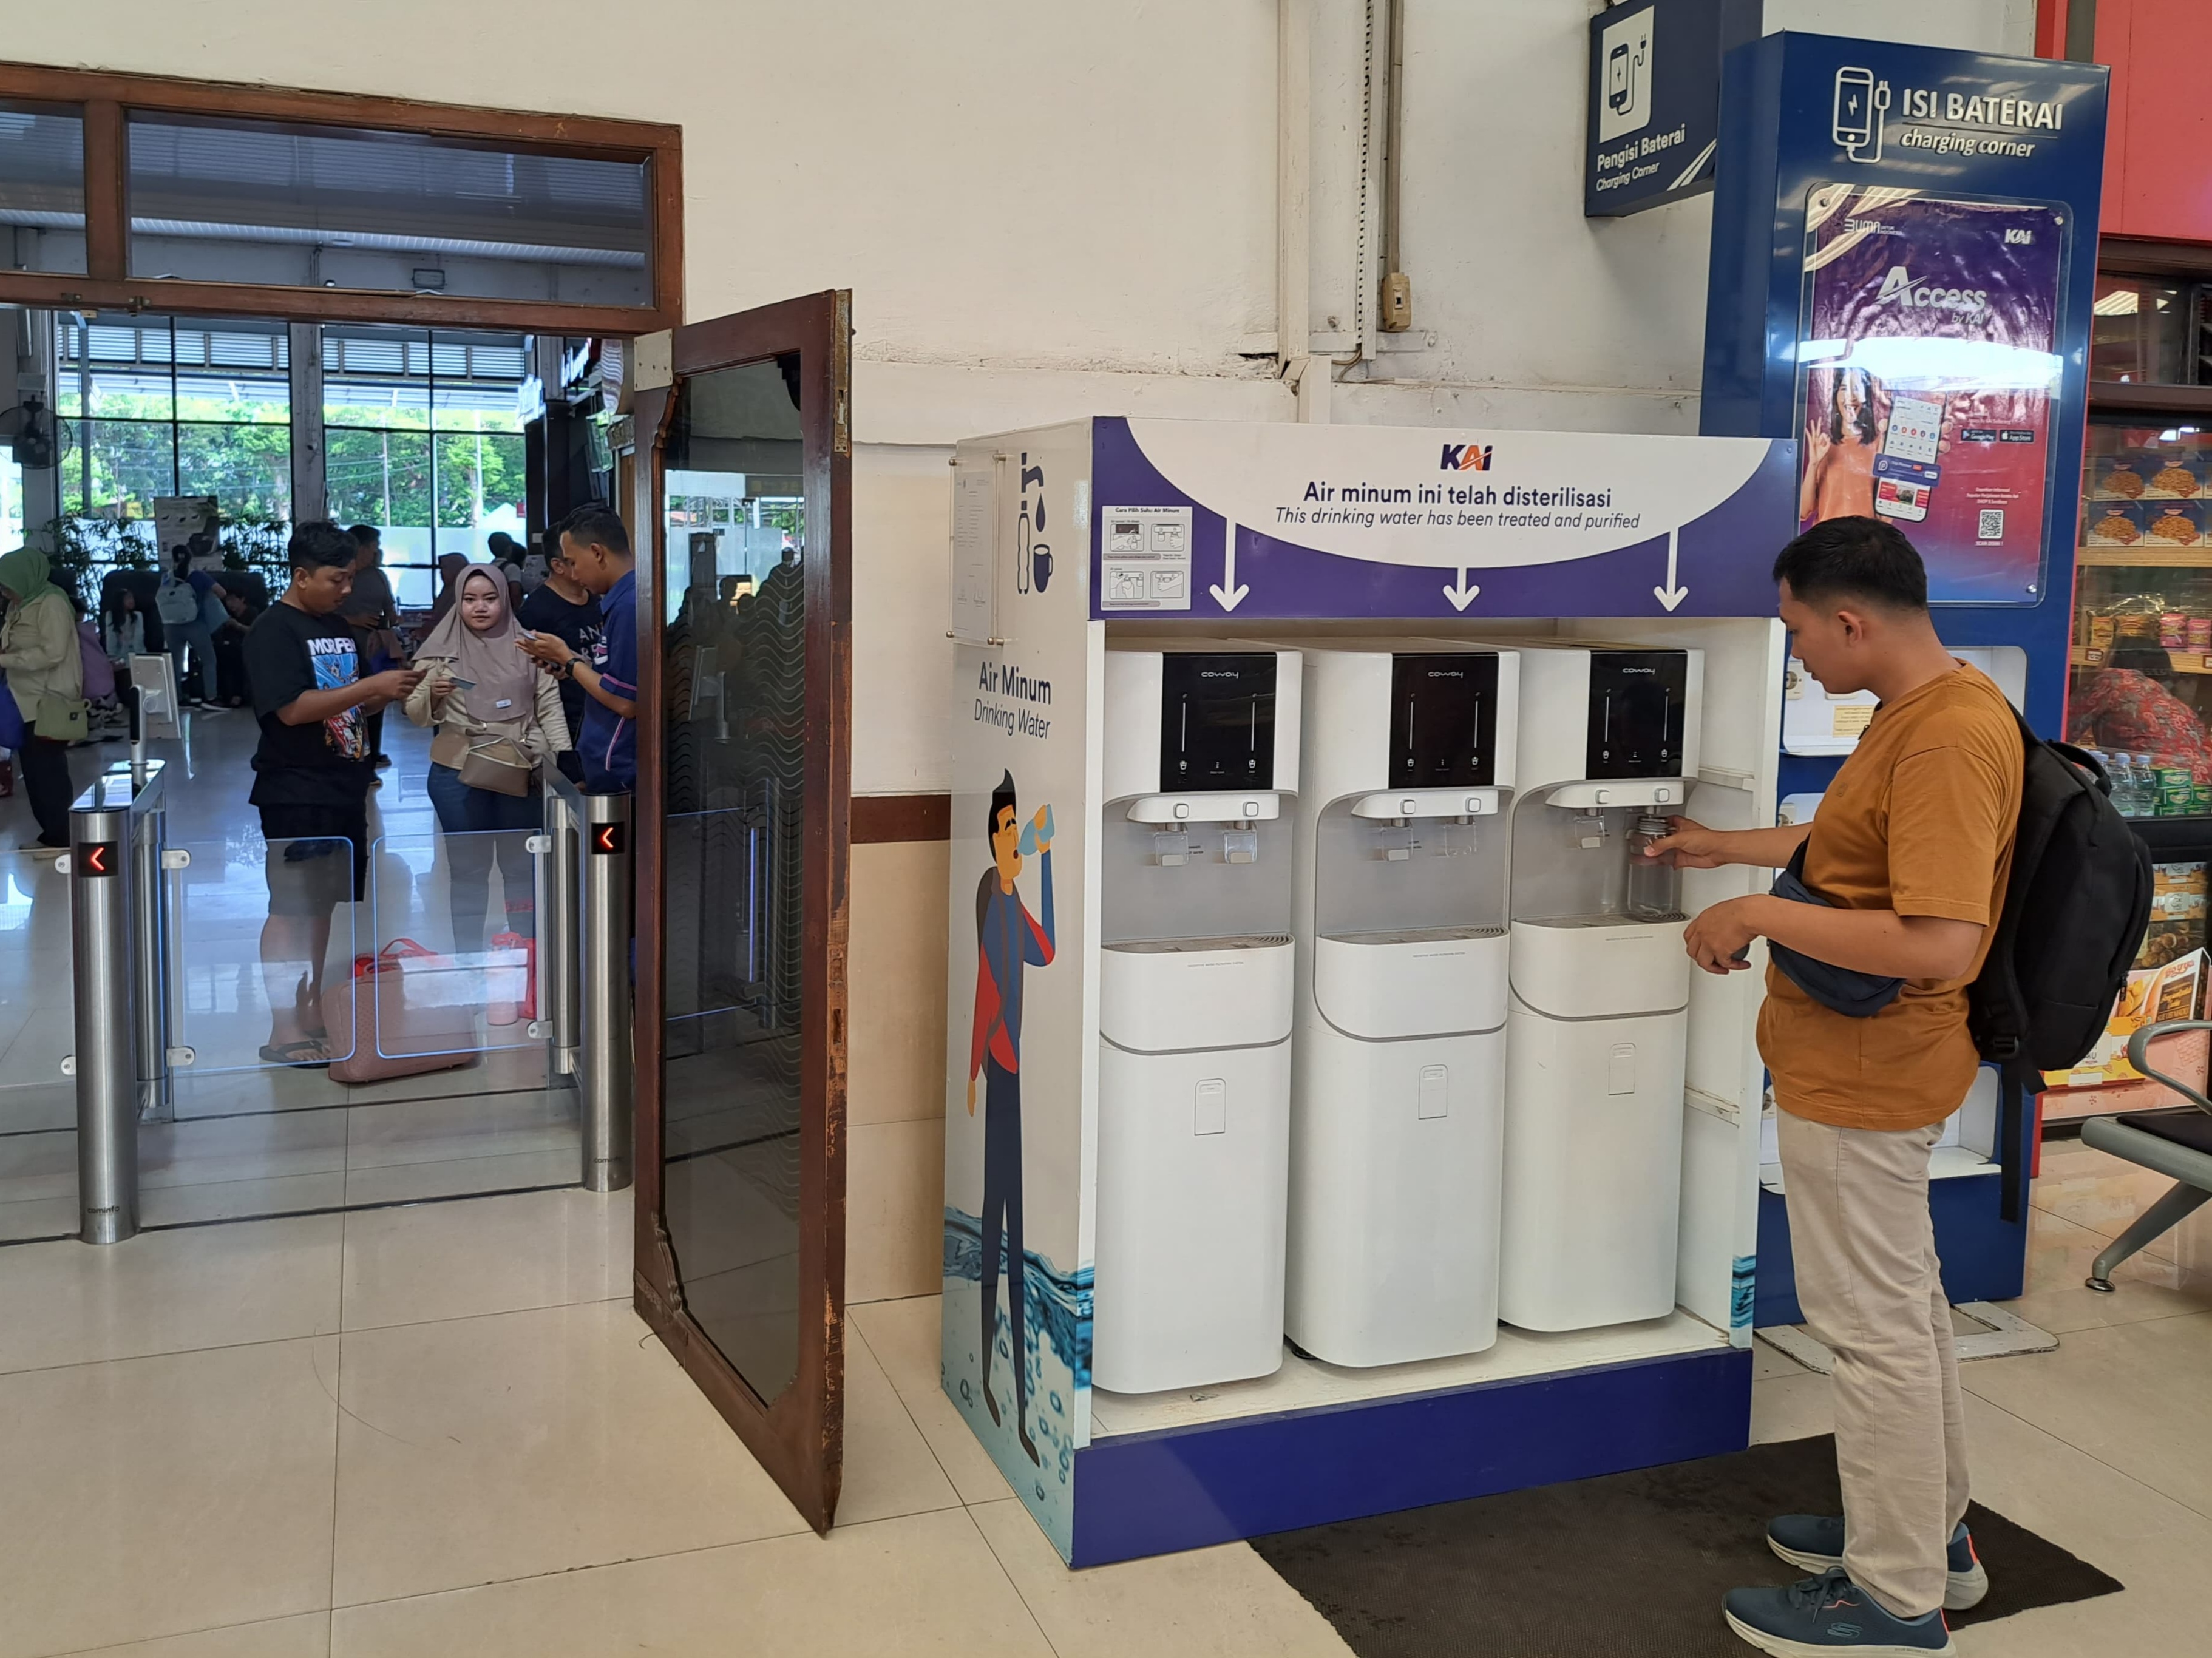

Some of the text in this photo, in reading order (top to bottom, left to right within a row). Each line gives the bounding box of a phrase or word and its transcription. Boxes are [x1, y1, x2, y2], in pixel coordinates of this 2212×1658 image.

[1902, 89, 2063, 130] ISI BATERAI
[1597, 123, 1685, 172] Pengisi Baterai
[1901, 129, 2035, 157] charging corner
[1596, 162, 1660, 191] Charging Corner
[2004, 229, 2032, 244] KAI
[1951, 312, 1984, 324] by KAI
[1440, 444, 1493, 471] KAI
[1303, 481, 1611, 507] Air minum ini telah disterilisasi
[1275, 507, 1641, 531] This drinking water has been treated and purified
[579, 623, 603, 643] AN
[979, 662, 1051, 705] Air Minum
[974, 699, 1051, 739] Drinking Water
[87, 1205, 120, 1214] cominfo
